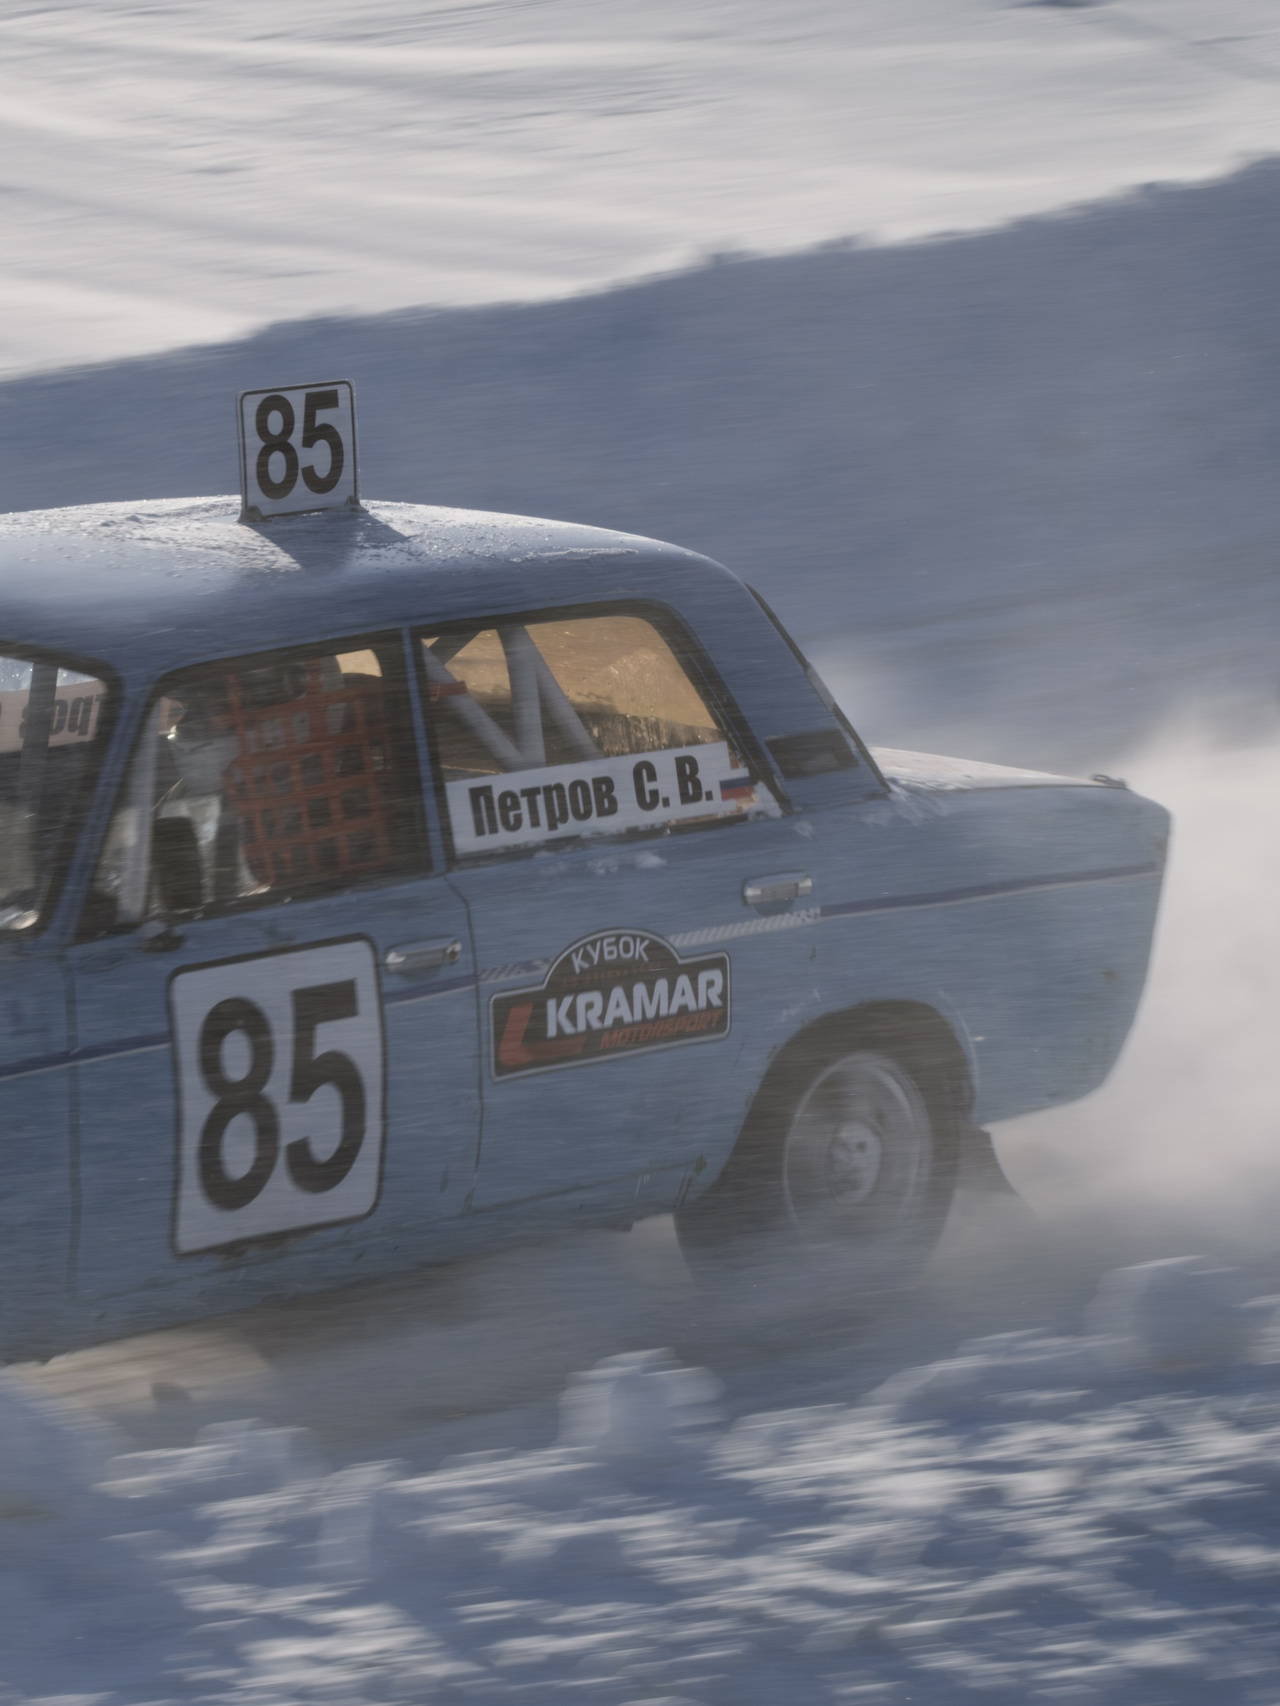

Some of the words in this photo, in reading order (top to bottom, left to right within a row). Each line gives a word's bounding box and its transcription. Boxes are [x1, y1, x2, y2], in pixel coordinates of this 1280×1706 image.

[255, 389, 344, 500] 85
[468, 775, 618, 837] Петров
[571, 935, 650, 974] КУБОК
[546, 968, 723, 1039] KRAMAR
[599, 1008, 725, 1050] MOTORSPORT
[198, 978, 367, 1212] 85
